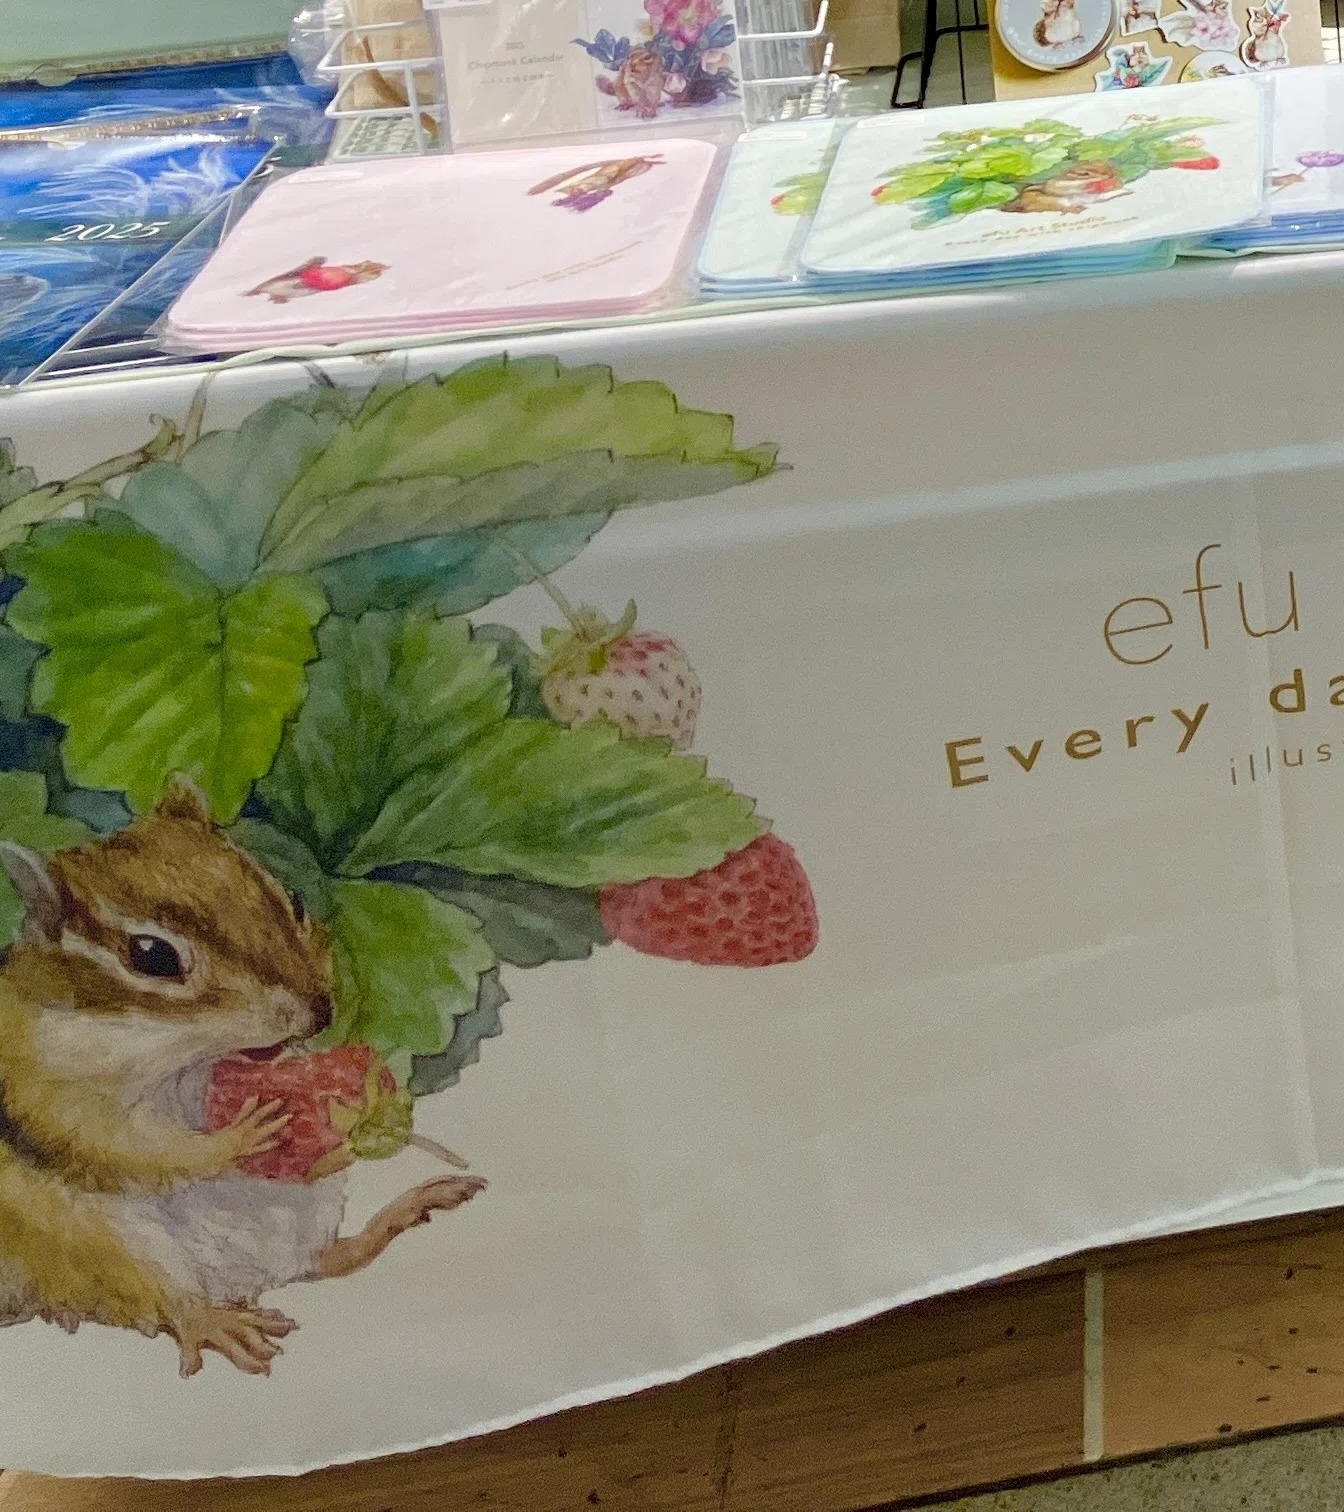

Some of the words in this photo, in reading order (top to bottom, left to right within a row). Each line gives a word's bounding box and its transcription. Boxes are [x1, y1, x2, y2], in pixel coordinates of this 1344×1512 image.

[44, 221, 171, 243] 2025
[1103, 542, 1302, 666] efu
[946, 696, 1211, 790] Every
